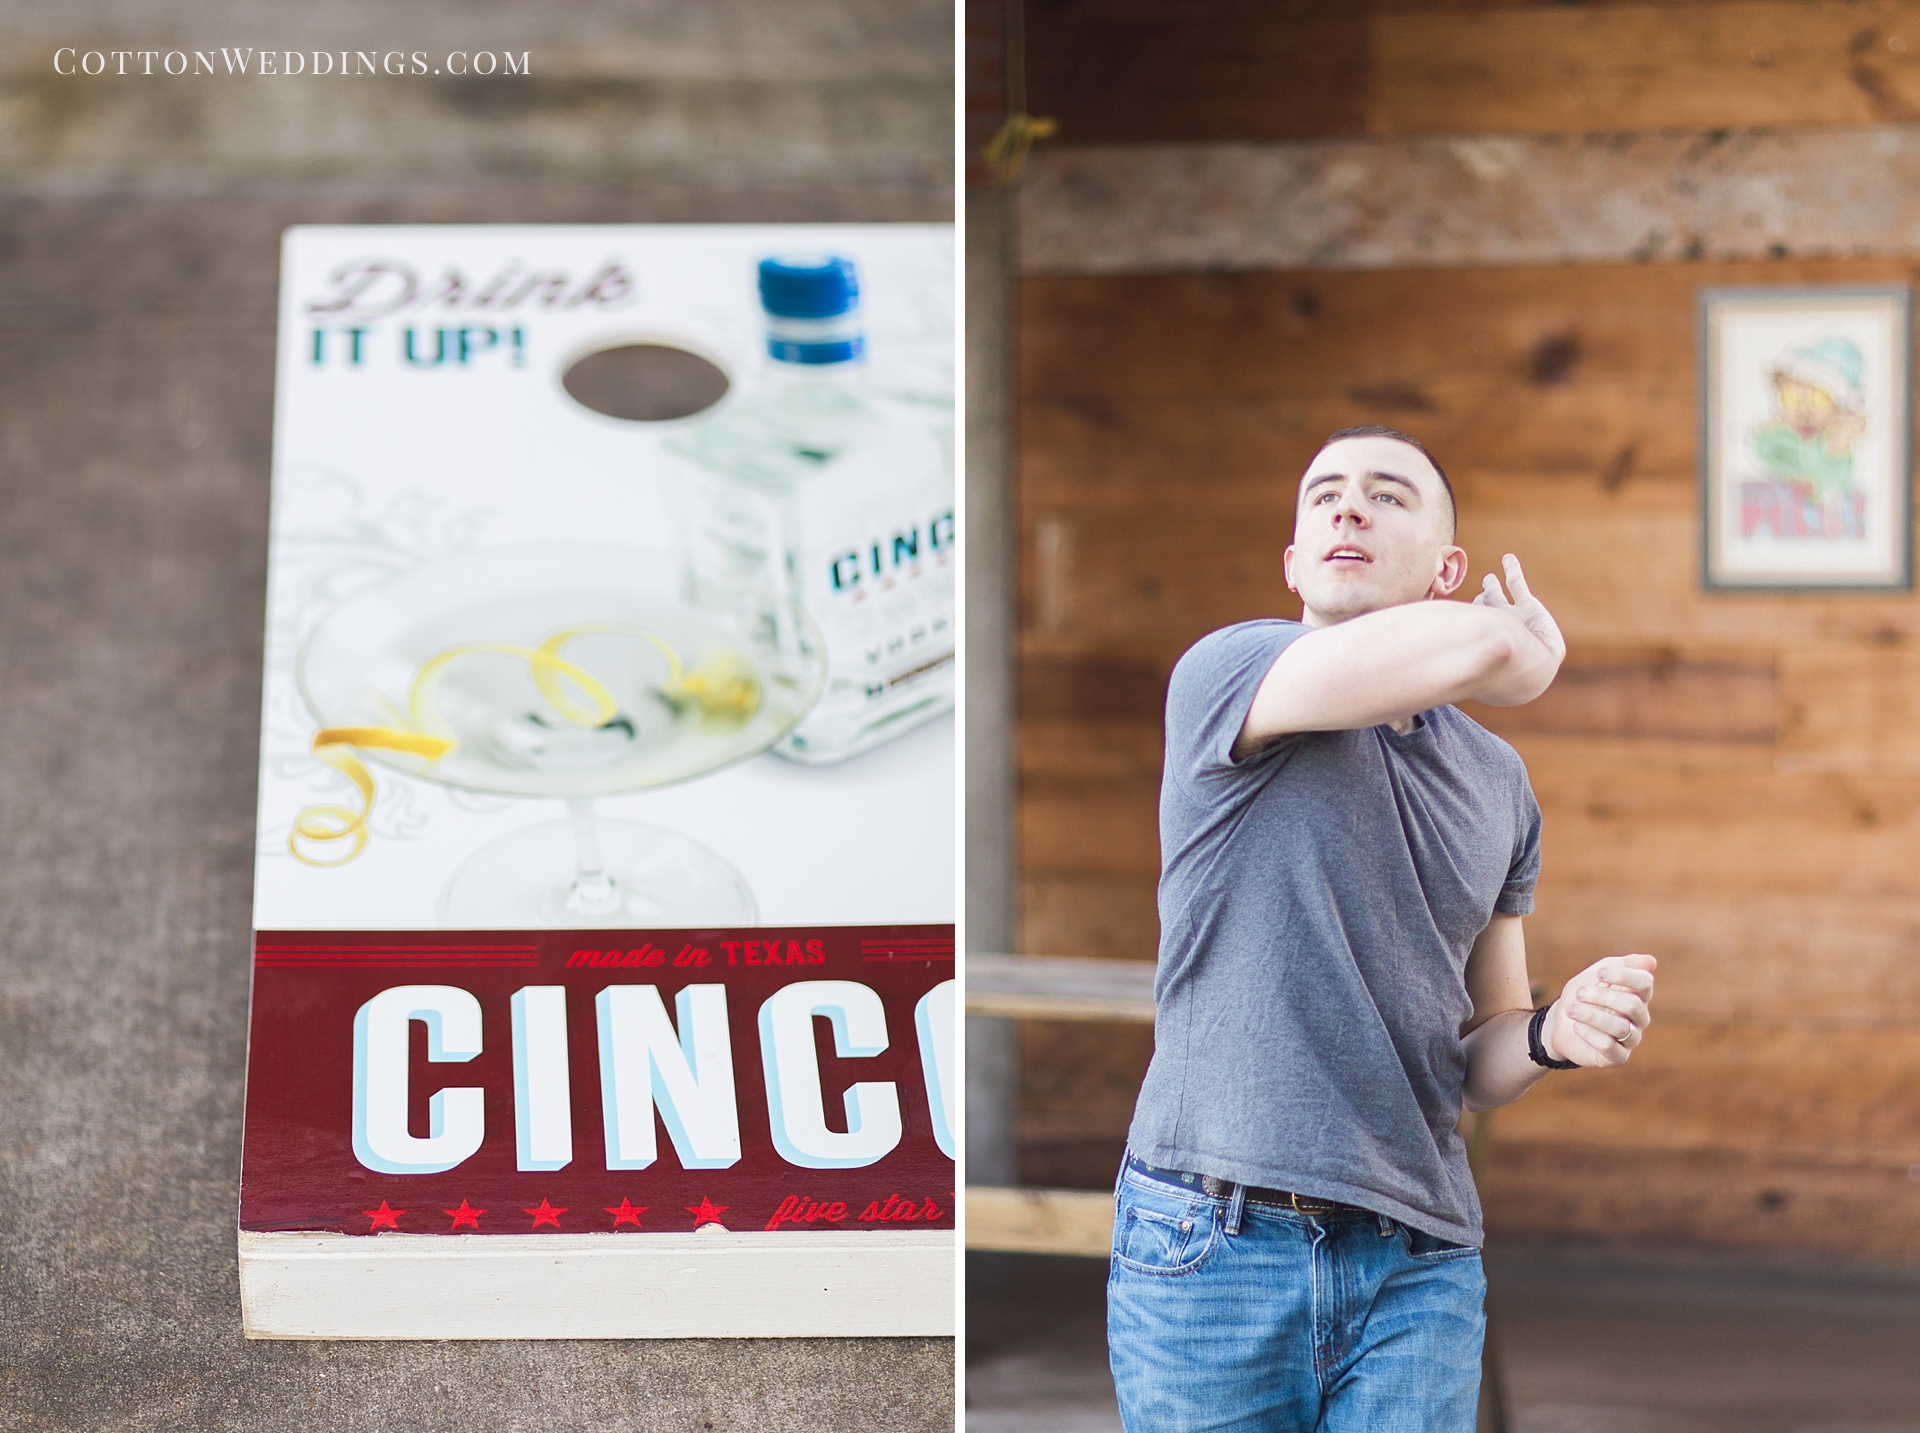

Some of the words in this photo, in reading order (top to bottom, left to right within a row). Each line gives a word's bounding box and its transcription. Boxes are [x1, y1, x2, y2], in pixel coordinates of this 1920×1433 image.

[306, 255, 638, 322] Drink
[309, 325, 373, 366] IT
[402, 325, 525, 368] UP!
[565, 944, 667, 968] made
[673, 944, 713, 967] in
[720, 940, 826, 966] TEXAS
[764, 1195, 849, 1231] five
[858, 1193, 945, 1221] star
